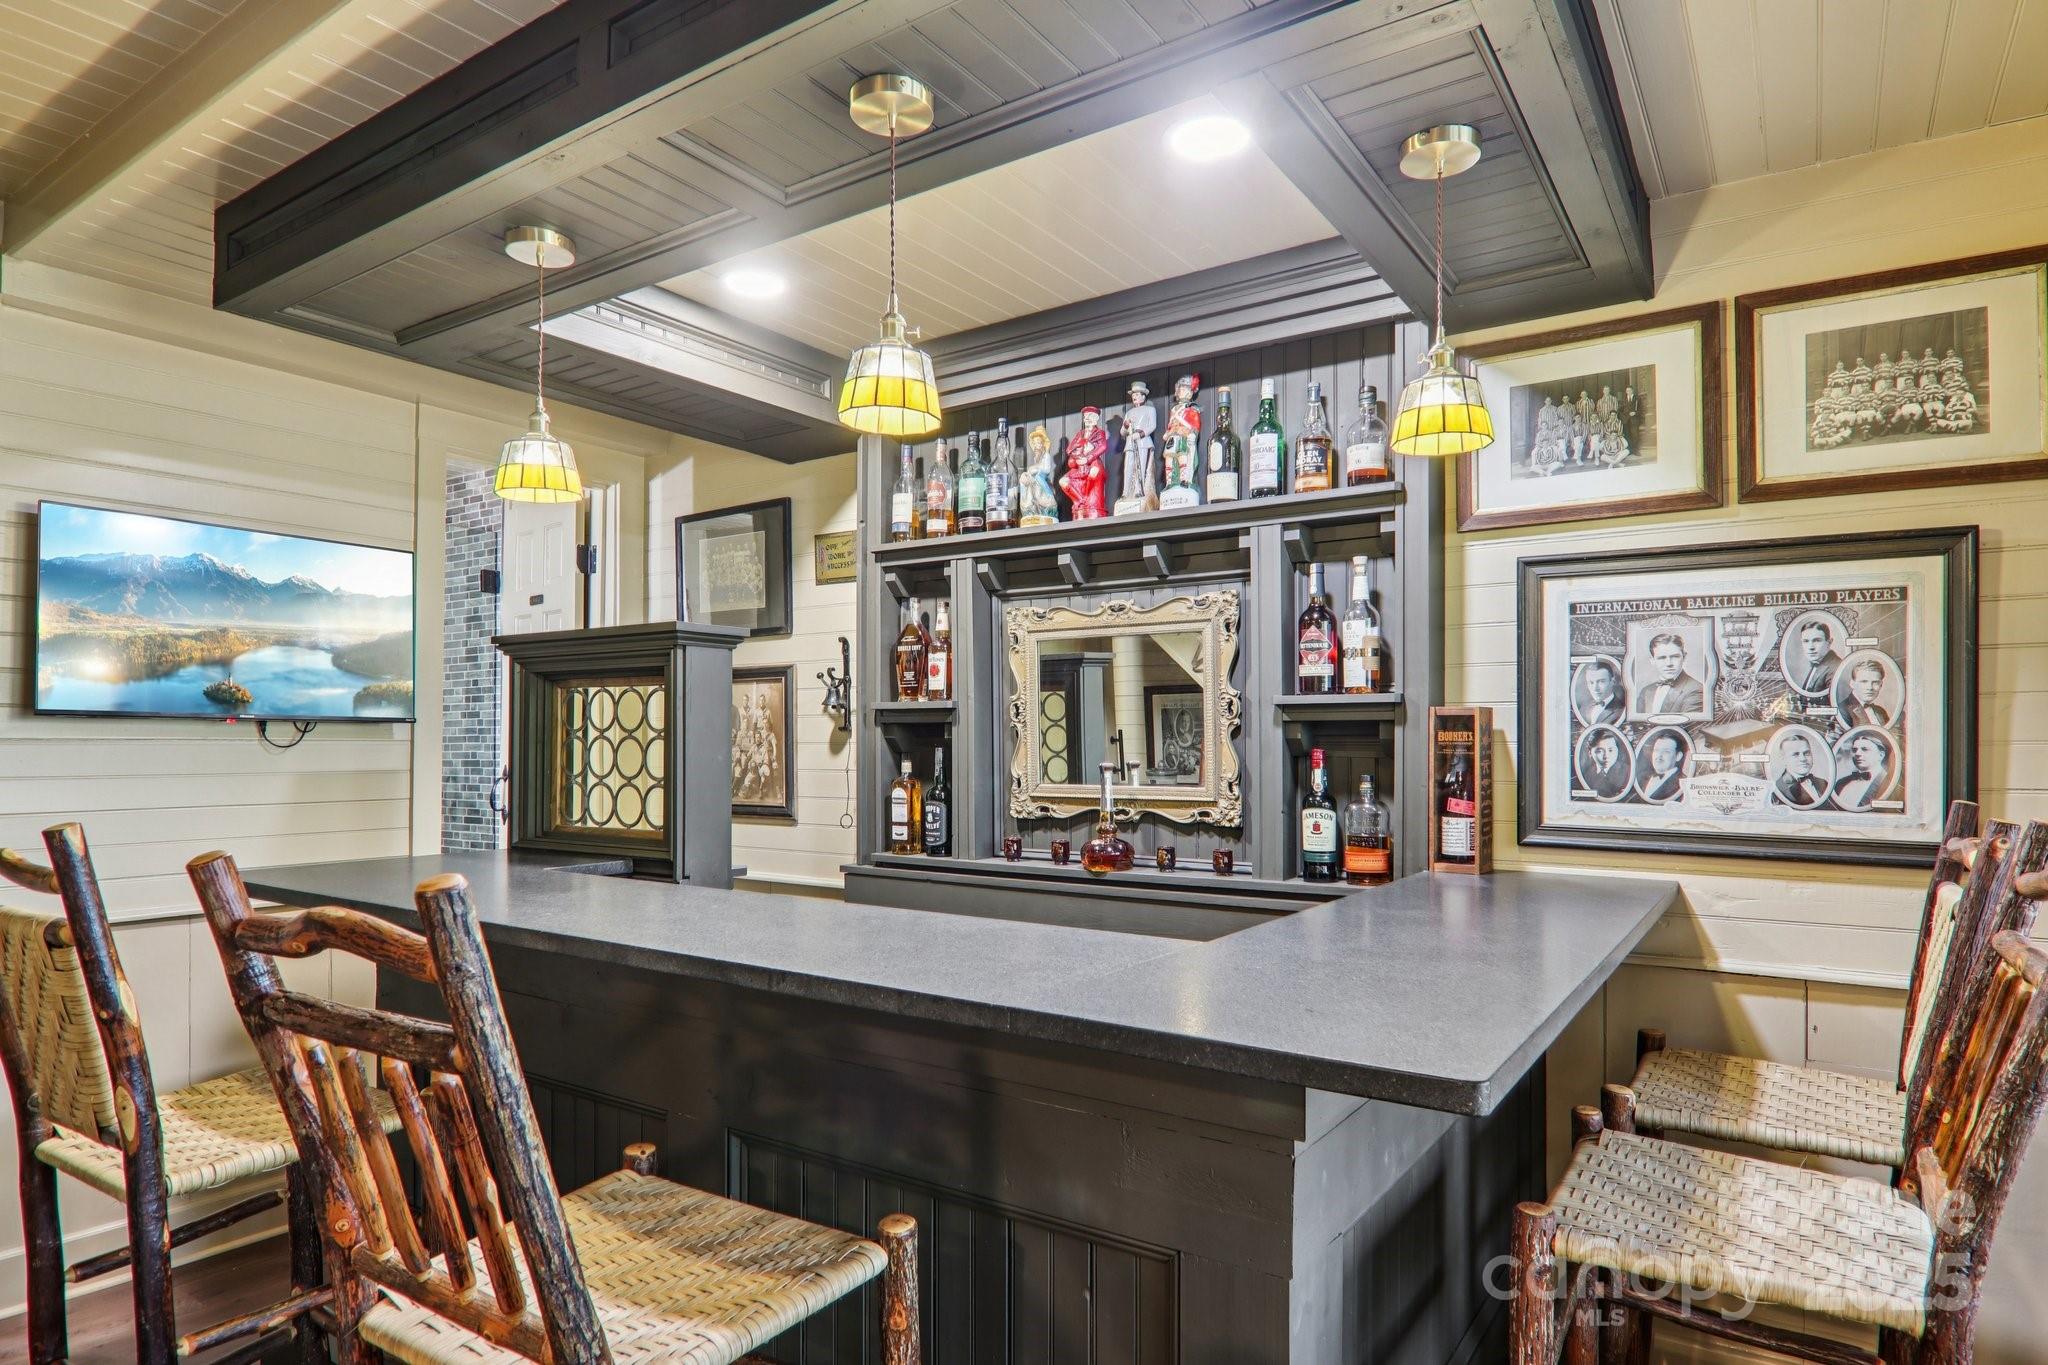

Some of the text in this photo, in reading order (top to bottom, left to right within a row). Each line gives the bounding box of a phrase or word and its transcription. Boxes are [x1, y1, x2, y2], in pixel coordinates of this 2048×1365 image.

[1575, 587, 1901, 615] INTERNATIONAL BALKLINE BILLIARD PLAYERS
